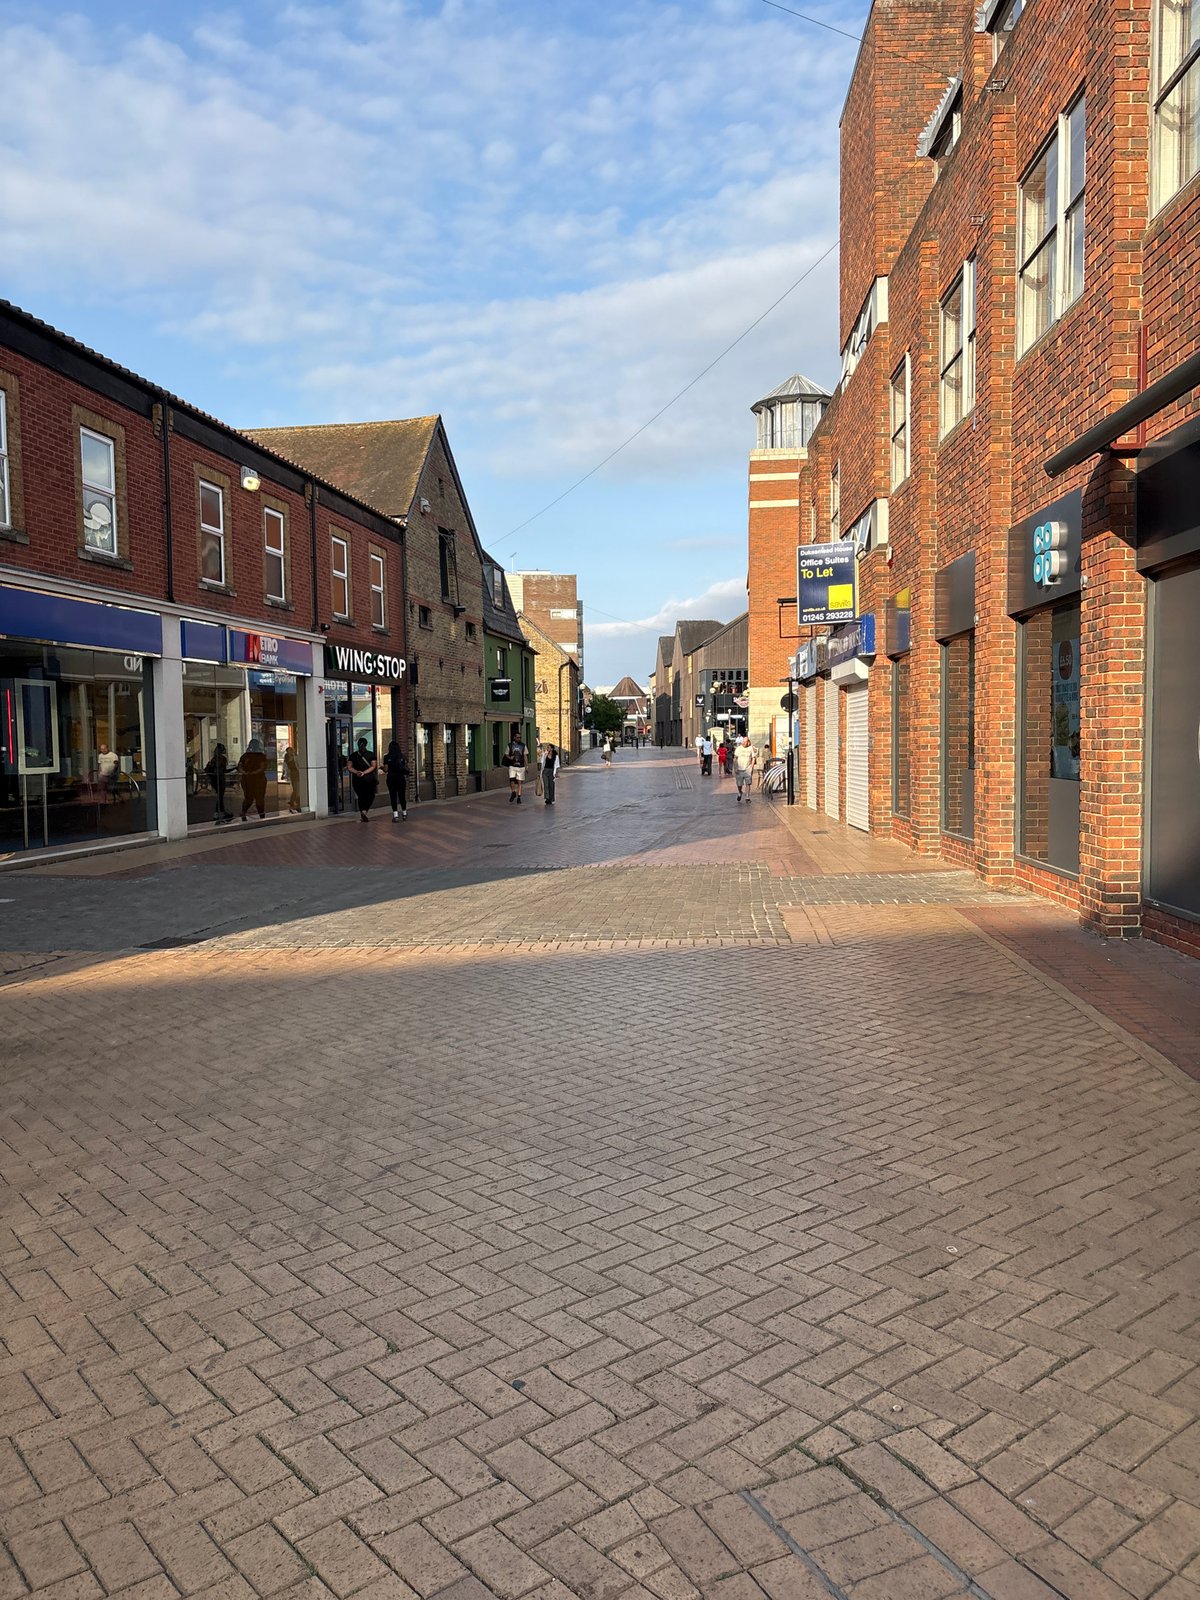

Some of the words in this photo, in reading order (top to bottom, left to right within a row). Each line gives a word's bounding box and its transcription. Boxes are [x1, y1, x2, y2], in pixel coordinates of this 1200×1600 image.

[800, 558, 823, 567] Office
[825, 557, 849, 565] Suites
[801, 568, 813, 579] To
[817, 567, 833, 578] Let
[803, 613, 825, 622] 01245
[826, 612, 853, 620] 293228
[260, 653, 279, 666] BANK
